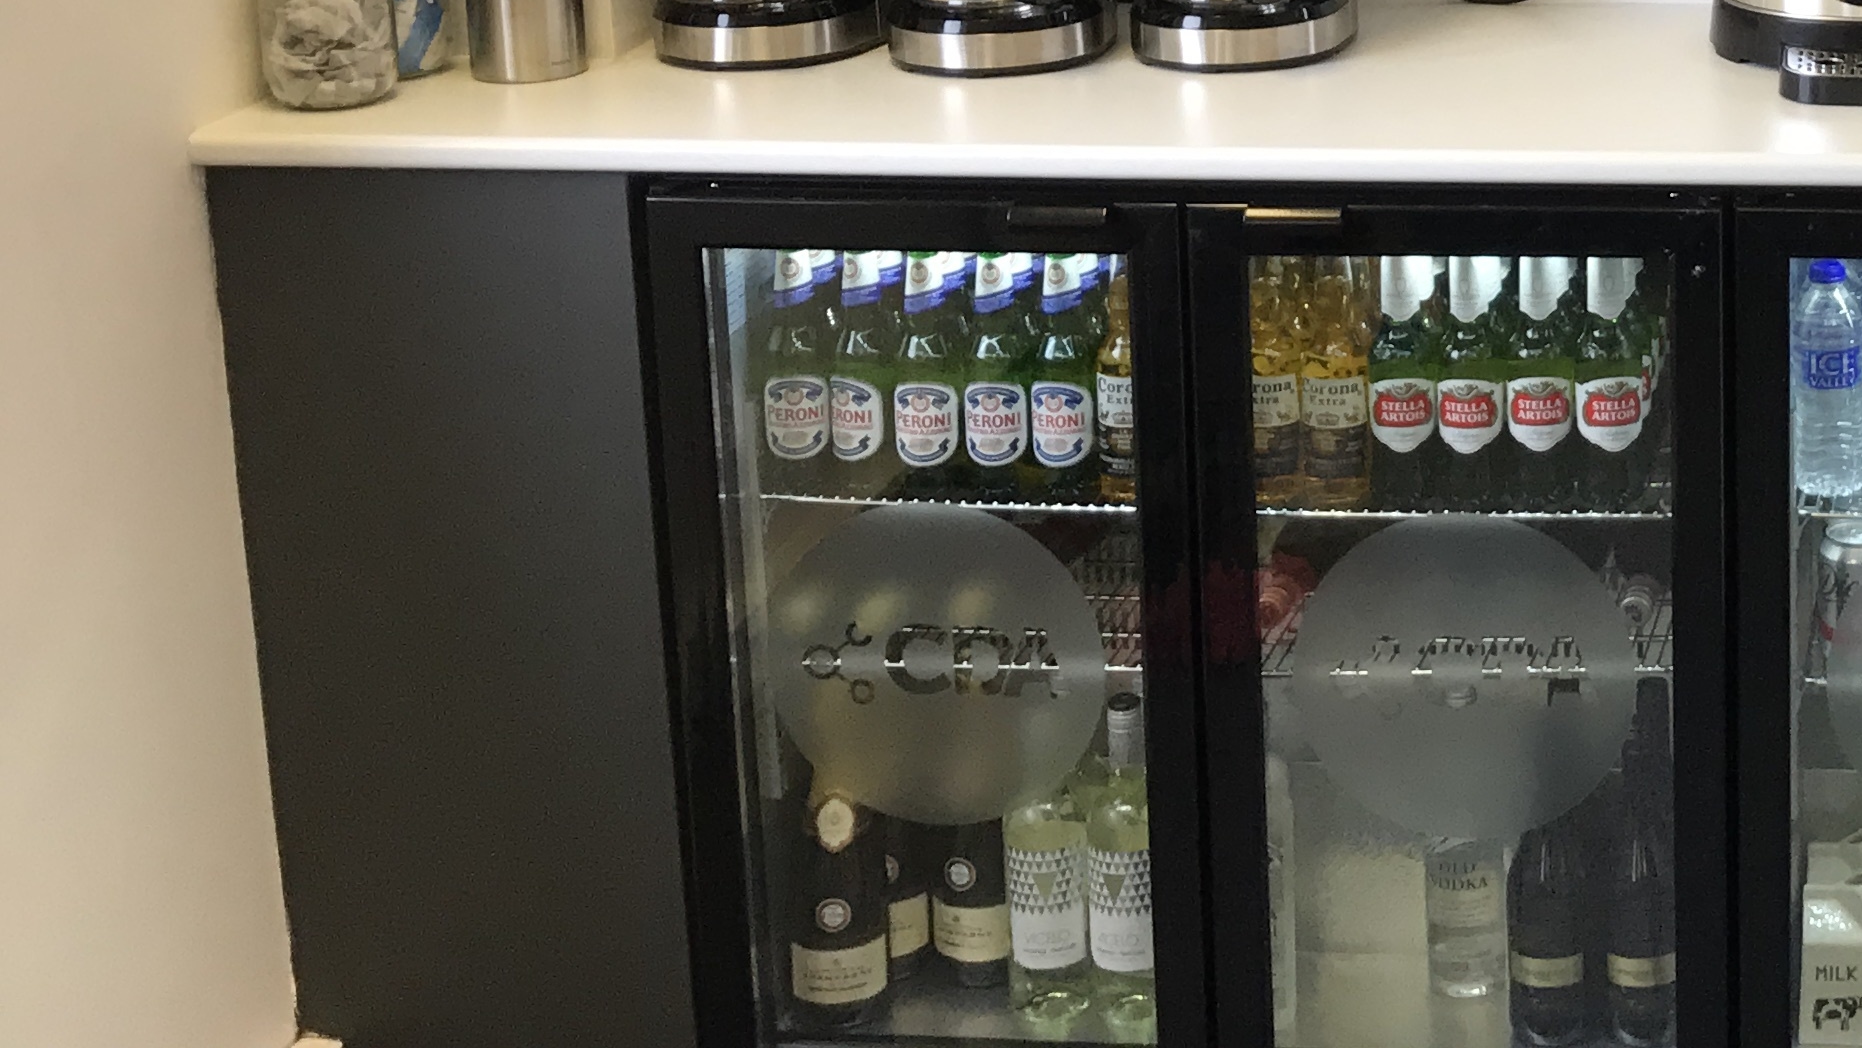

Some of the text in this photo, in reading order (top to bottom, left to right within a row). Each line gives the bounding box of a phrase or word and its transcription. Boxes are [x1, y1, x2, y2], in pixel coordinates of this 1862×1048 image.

[1381, 400, 1425, 411] STELLA
[1444, 401, 1488, 412] STELLA
[1517, 398, 1562, 409] STELLA
[1591, 398, 1636, 411] STELLA
[767, 404, 824, 422] PERONI
[1380, 410, 1426, 422] ARTOIS
[1444, 412, 1489, 422] ARTOIS
[1517, 408, 1563, 420] ARTOIS
[1591, 409, 1636, 422] ARTOIS
[896, 412, 951, 428] PERONI
[967, 412, 1021, 428] PERONI
[1032, 411, 1085, 429] PERONI
[884, 623, 1060, 698] CDA
[1815, 965, 1858, 982] MILK
